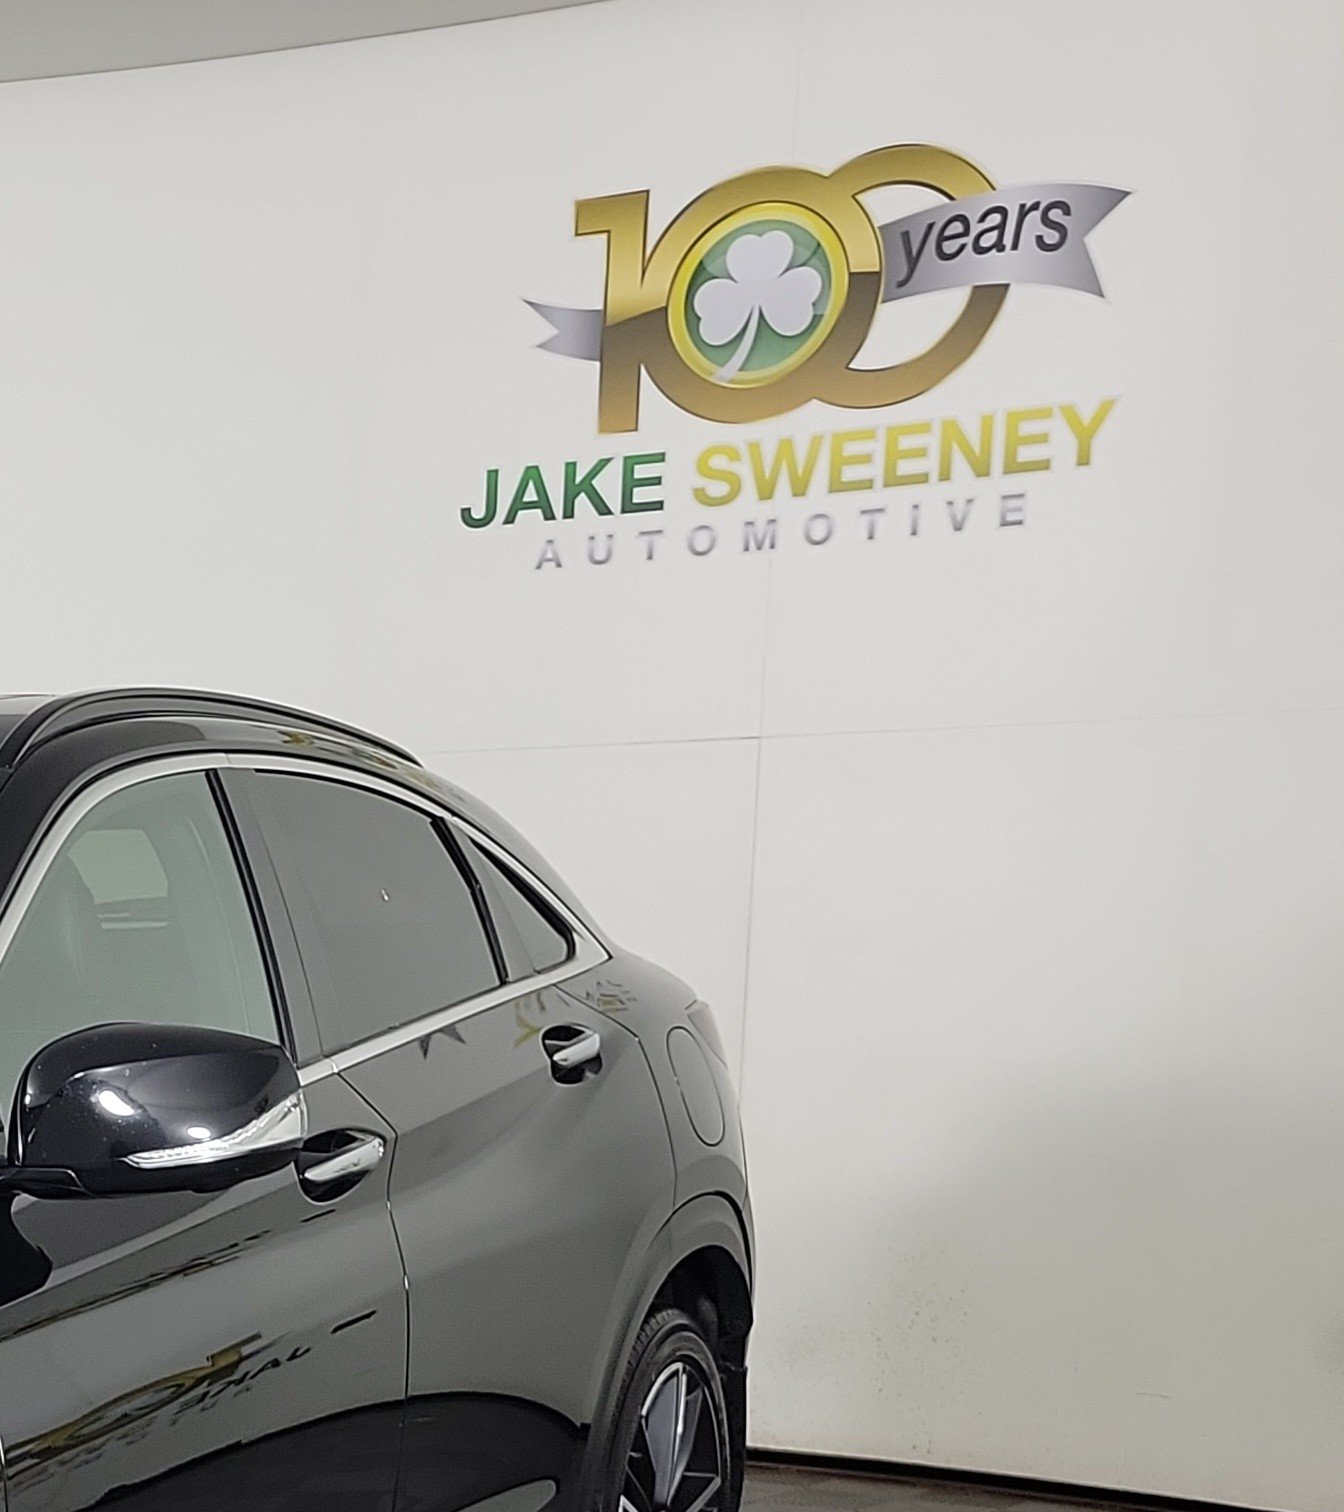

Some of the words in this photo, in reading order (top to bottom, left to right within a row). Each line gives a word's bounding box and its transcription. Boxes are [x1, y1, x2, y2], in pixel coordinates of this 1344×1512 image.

[897, 198, 1073, 288] years
[459, 450, 667, 529] JAKE
[692, 397, 1118, 507] SWEENEY
[534, 492, 1027, 570] AUTOMOTIVE
